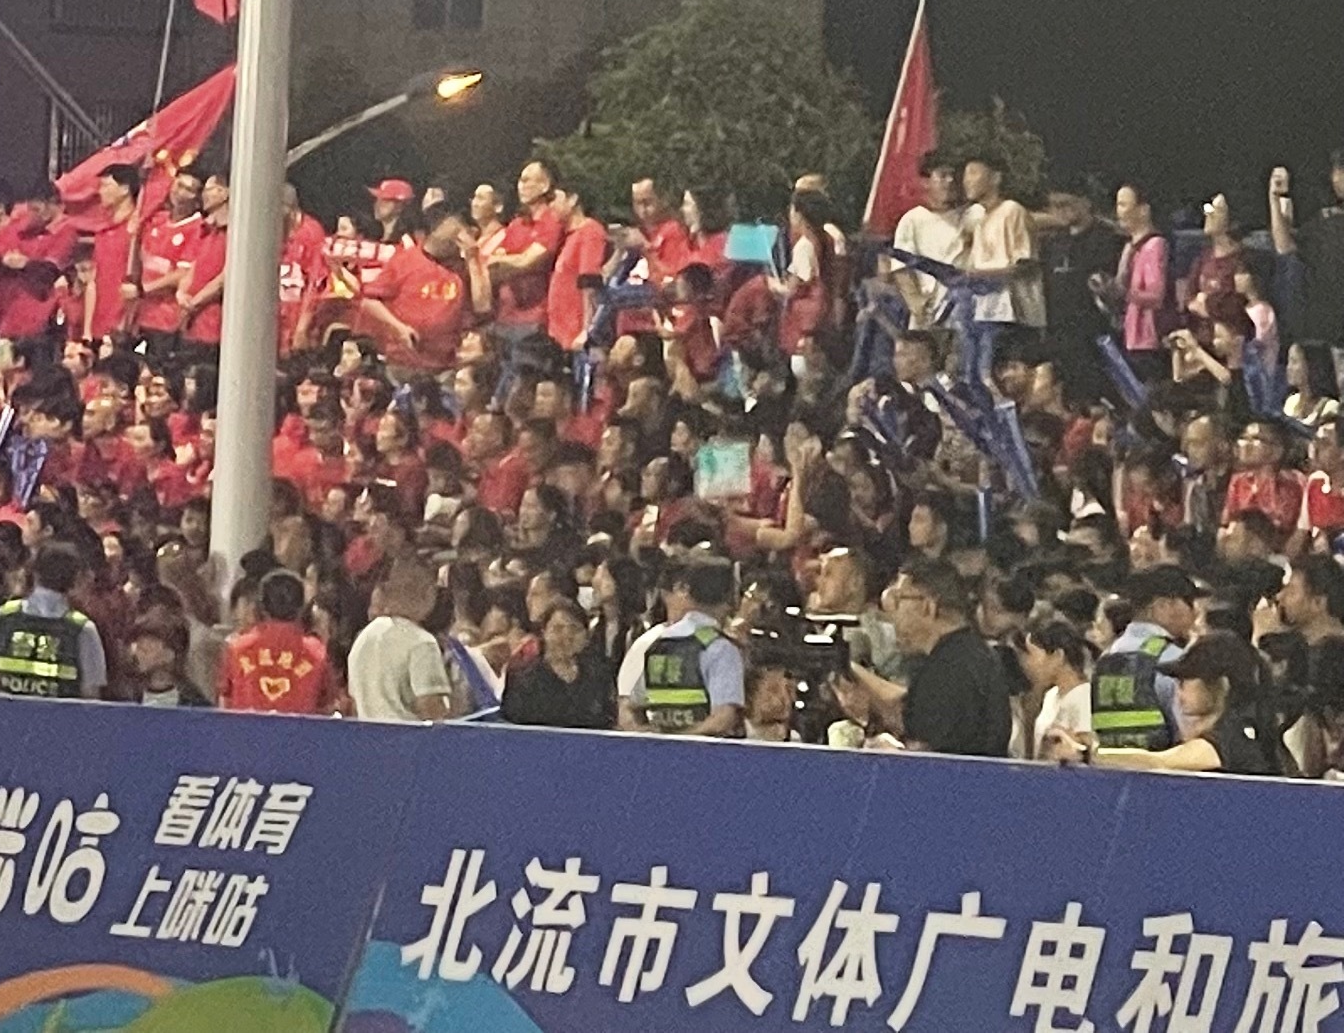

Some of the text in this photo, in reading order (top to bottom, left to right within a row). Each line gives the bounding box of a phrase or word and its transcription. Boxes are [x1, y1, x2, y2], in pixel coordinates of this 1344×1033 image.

[153, 773, 315, 856] 看体育
[108, 864, 270, 948] 上咪咕
[401, 847, 1344, 1033] 北流市文体广电和旅
